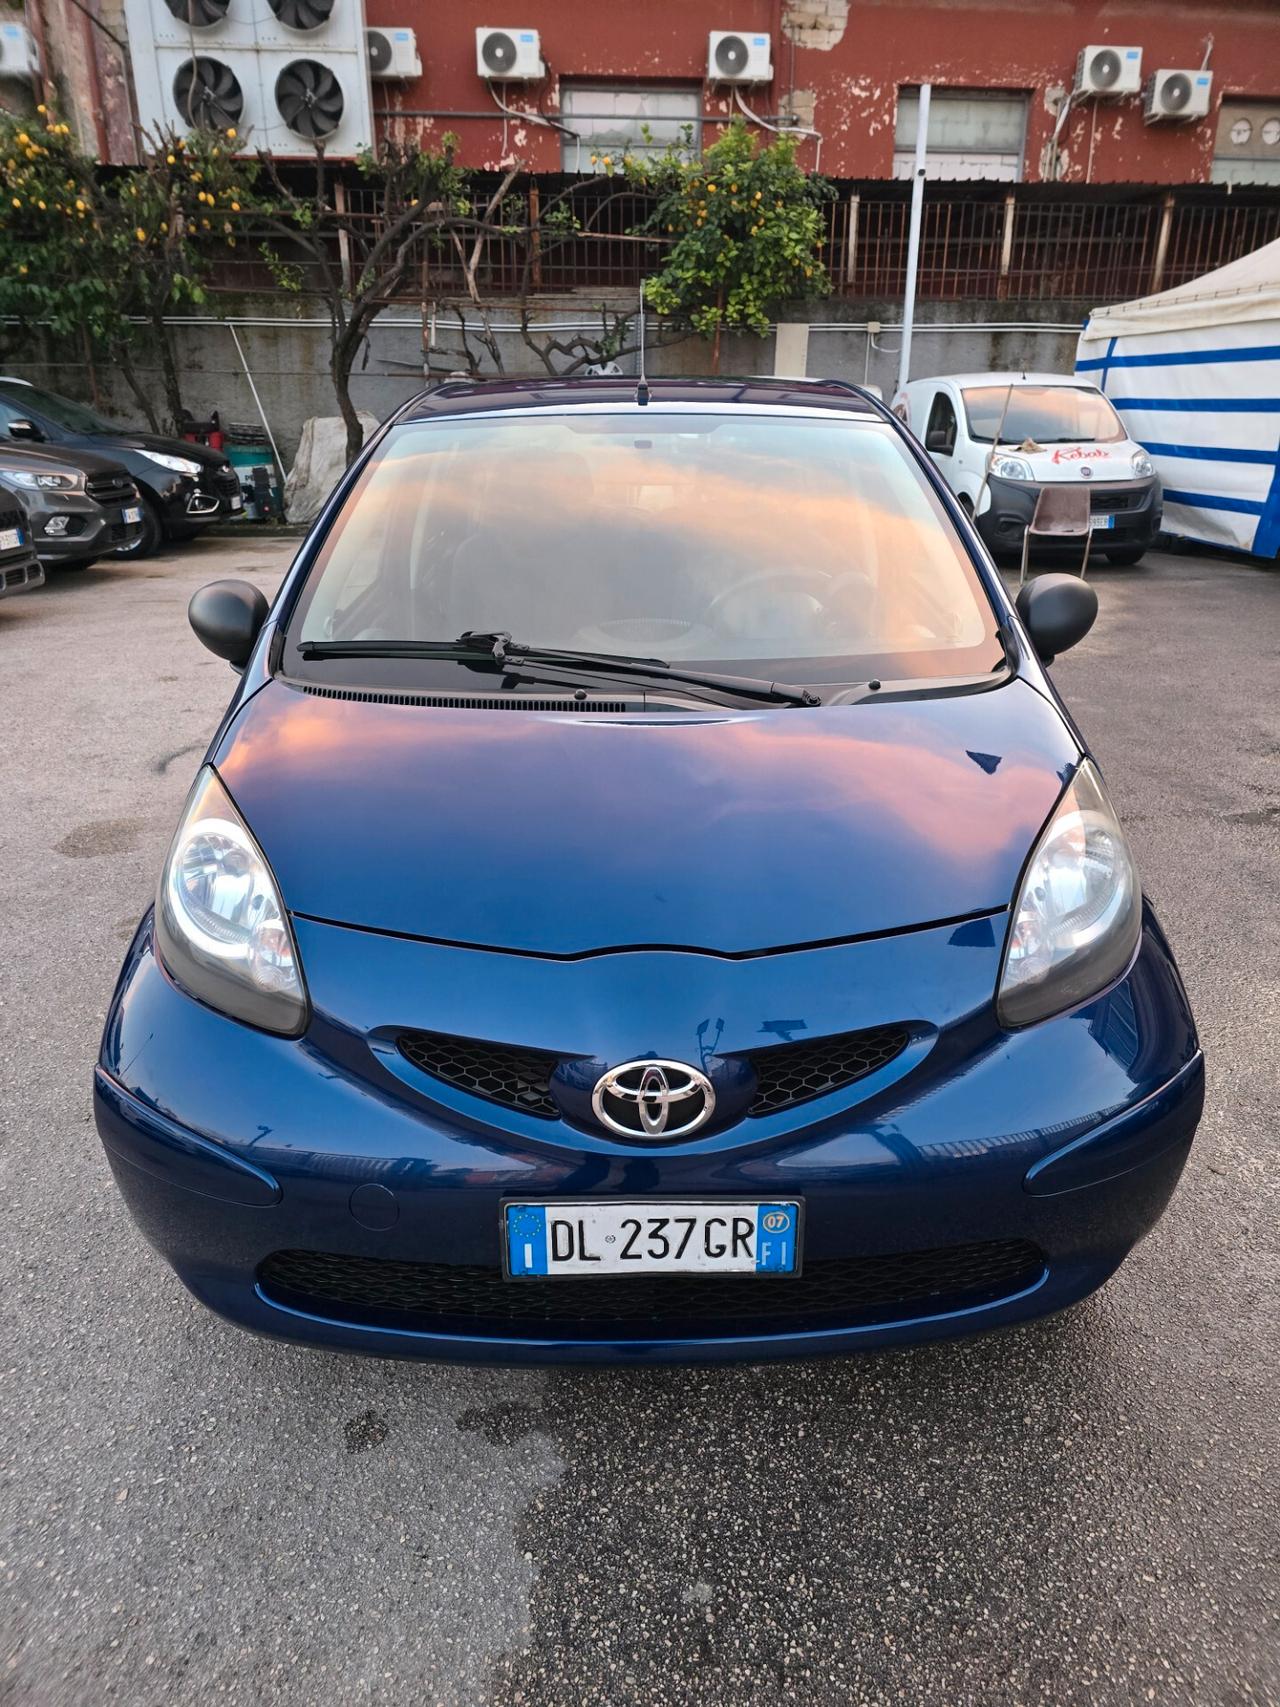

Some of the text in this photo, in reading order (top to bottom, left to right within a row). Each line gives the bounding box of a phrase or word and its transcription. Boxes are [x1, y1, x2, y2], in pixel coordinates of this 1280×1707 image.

[767, 1215, 785, 1229] 07
[551, 1218, 755, 1261] DL 237GR
[524, 1243, 533, 1269] I
